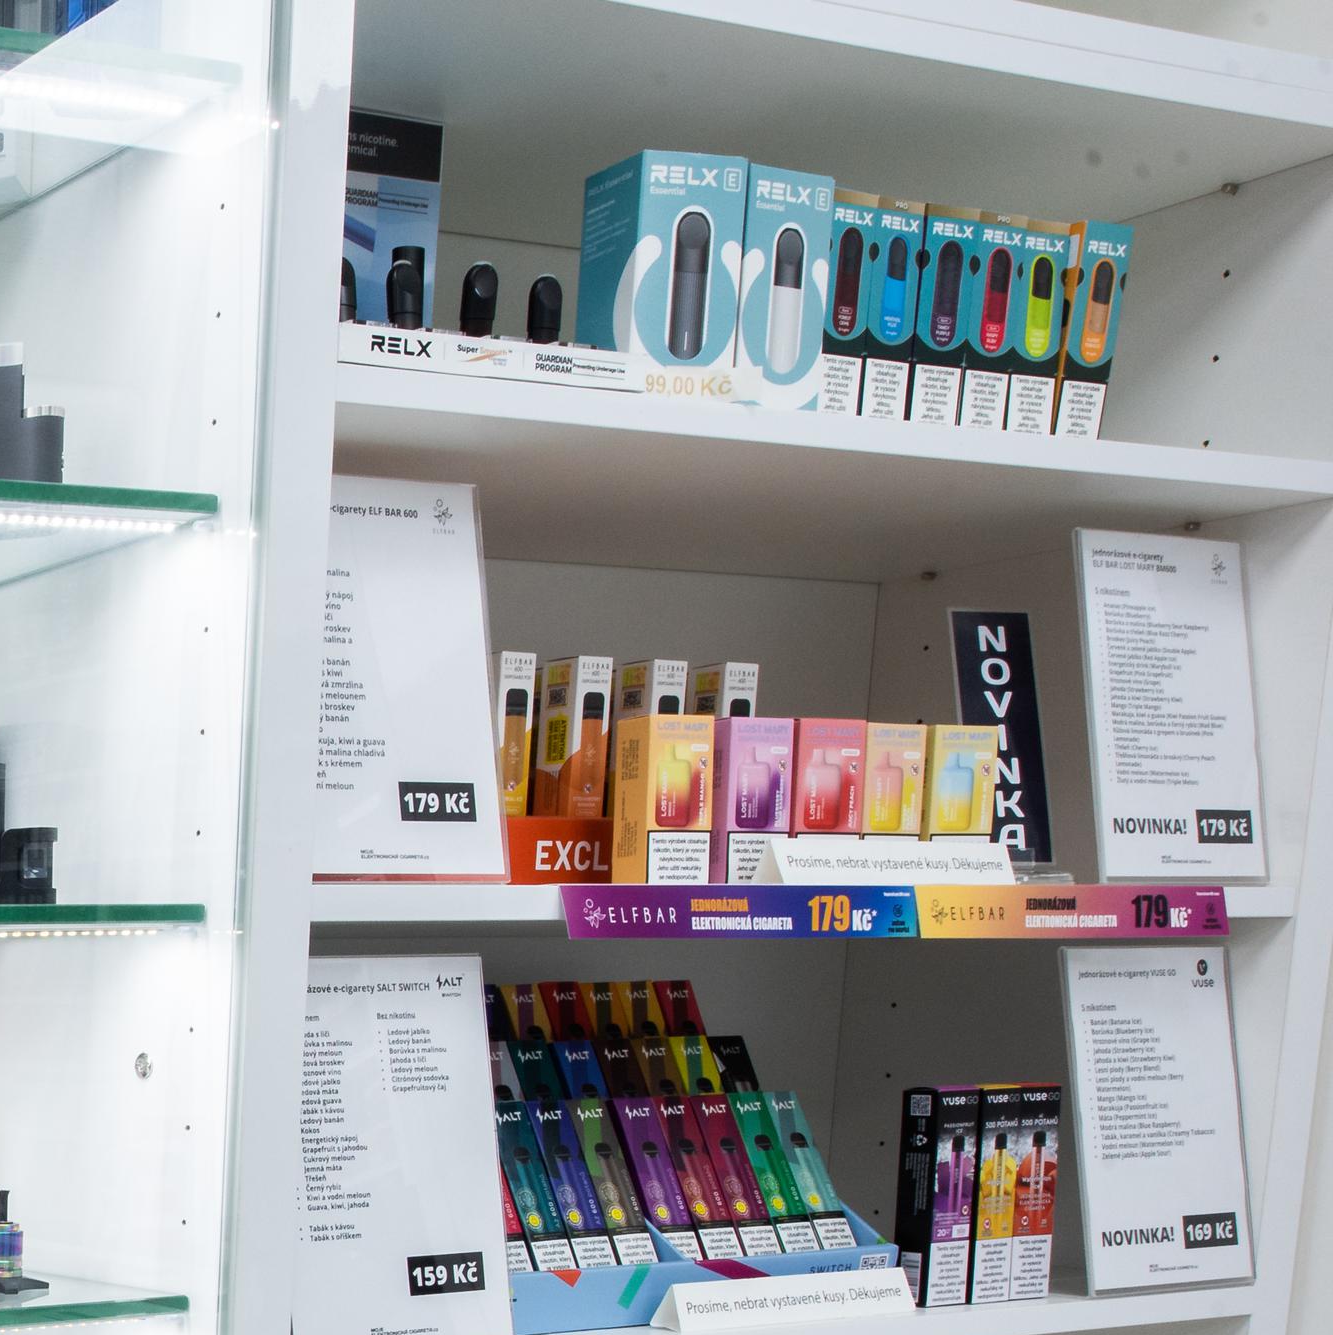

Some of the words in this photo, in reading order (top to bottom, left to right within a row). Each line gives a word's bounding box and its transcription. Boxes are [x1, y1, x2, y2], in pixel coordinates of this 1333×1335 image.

[650, 165, 717, 187] RELX
[757, 179, 810, 205] RELX
[933, 222, 974, 239] RELX
[1087, 241, 1127, 257] RELX
[371, 334, 432, 358] RELX
[369, 506, 382, 515] ELF
[385, 508, 402, 517] BAR
[404, 509, 418, 518] 600
[977, 625, 1025, 849] NOVINKA
[404, 793, 439, 813] 179
[445, 792, 469, 814] Kč
[1113, 818, 1186, 835] NOVINKA!
[1200, 819, 1226, 836] 179
[1230, 816, 1248, 836] Kč
[535, 840, 609, 871] EXCL
[691, 897, 749, 911] JEDNORÁZOVÁ
[808, 895, 850, 932] 179
[609, 907, 677, 924] ELFBAR
[692, 915, 752, 931] ELEKTRONICKÁ
[753, 916, 793, 930] CIGARETA
[333, 983, 375, 994] e-cigarety
[377, 983, 396, 992] SALT
[399, 982, 429, 991] SWITCH
[1102, 1226, 1174, 1247] NOVINKA!
[1186, 1223, 1212, 1241] 169
[1216, 1219, 1233, 1240] Kč
[413, 1265, 447, 1287] 159
[453, 1262, 478, 1284] Kč
[686, 1301, 732, 1314] Prosíme,
[734, 1298, 768, 1311] nebrat
[769, 1291, 821, 1310] vystavené
[823, 1290, 848, 1304] kusy.
[849, 1286, 901, 1300] Děkujeme
